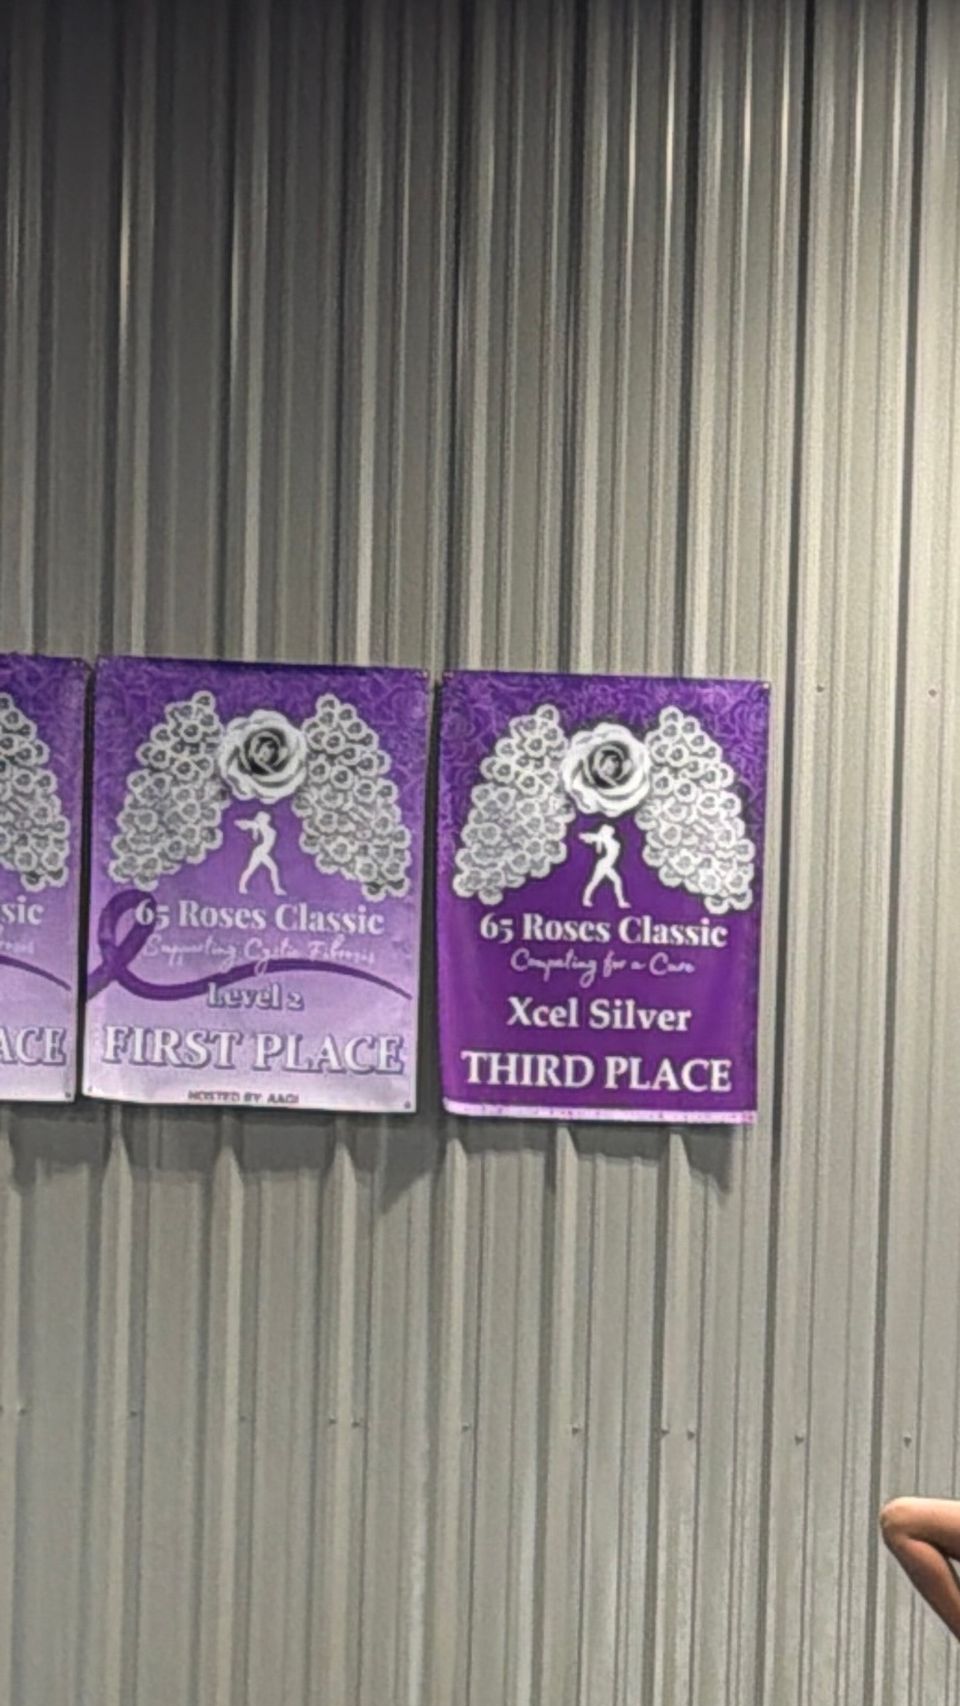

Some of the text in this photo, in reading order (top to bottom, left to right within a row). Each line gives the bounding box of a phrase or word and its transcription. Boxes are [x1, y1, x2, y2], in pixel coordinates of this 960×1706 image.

[135, 901, 386, 935] 65 Roses Classic
[480, 912, 729, 948] 65 Roses Classic
[141, 934, 376, 975] Supporting Cystic Fibrosis
[511, 948, 696, 988] Competing for a Cure
[206, 982, 305, 1011] Level 2
[507, 996, 692, 1031] Xcel Silver
[102, 1024, 405, 1075] FIRST PLACE
[460, 1050, 733, 1092] THIRD PLACE
[188, 1089, 240, 1101] HOSTED
[244, 1091, 263, 1102] BY
